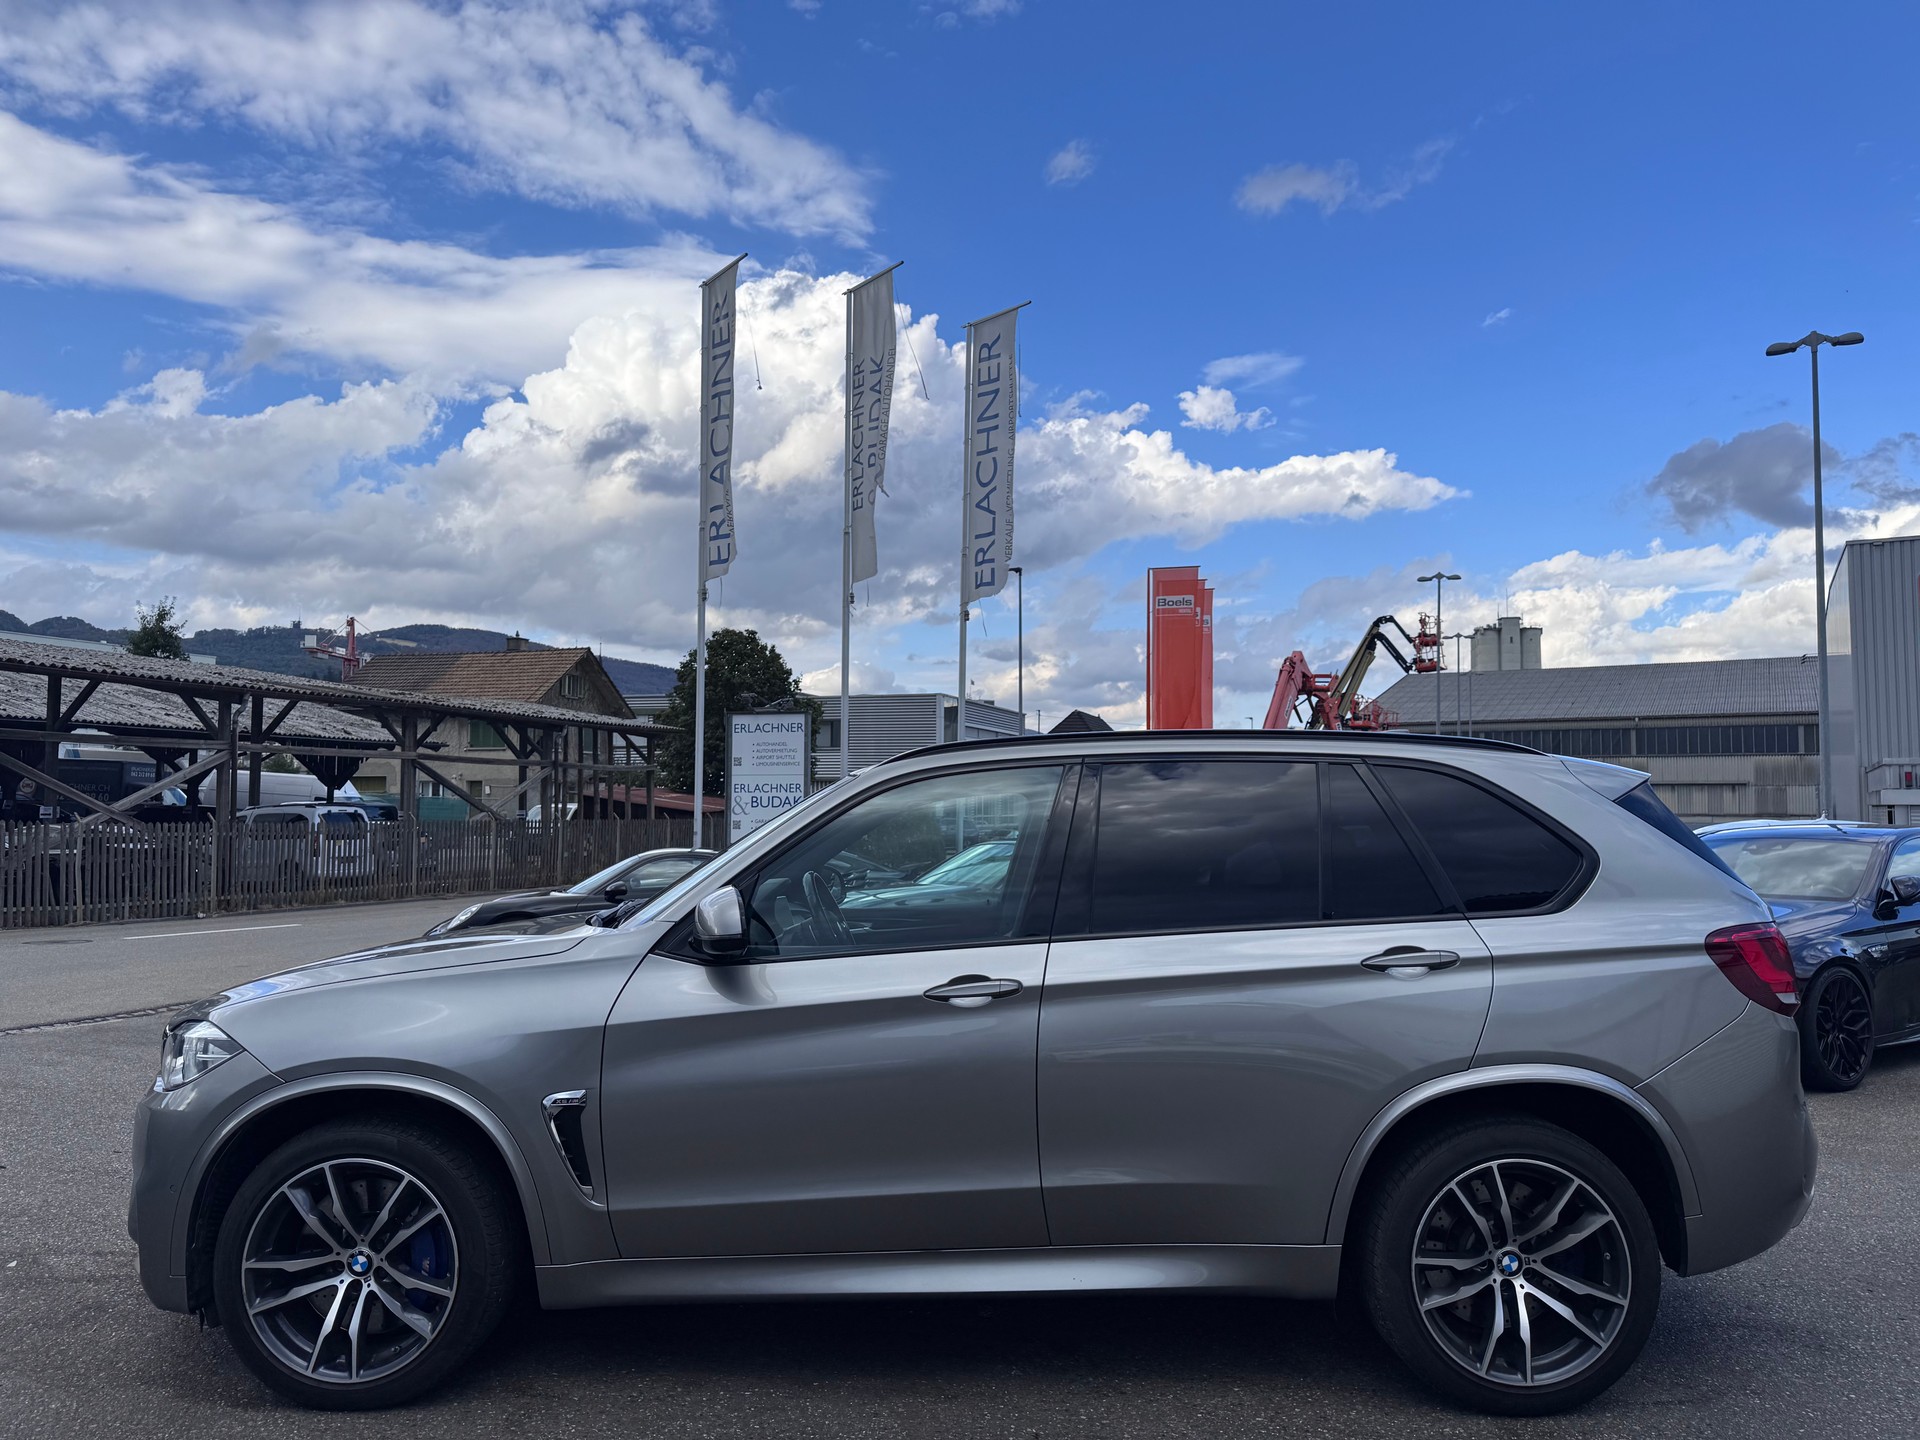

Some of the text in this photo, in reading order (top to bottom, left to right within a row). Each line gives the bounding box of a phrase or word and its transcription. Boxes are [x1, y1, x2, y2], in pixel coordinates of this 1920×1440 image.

[881, 345, 896, 417] AUTOHANDEL
[708, 290, 732, 567] ERLACHNER
[852, 358, 865, 512] ERLACHNER
[877, 419, 889, 461] GARAGE
[974, 332, 1002, 590] ERLACHNER
[1004, 518, 1014, 563] VERKAUF
[1157, 597, 1193, 607] Boels
[734, 723, 804, 733] ERLACHNER
[732, 795, 802, 816] & BUDAK
[734, 783, 802, 793] ERLACHNER
